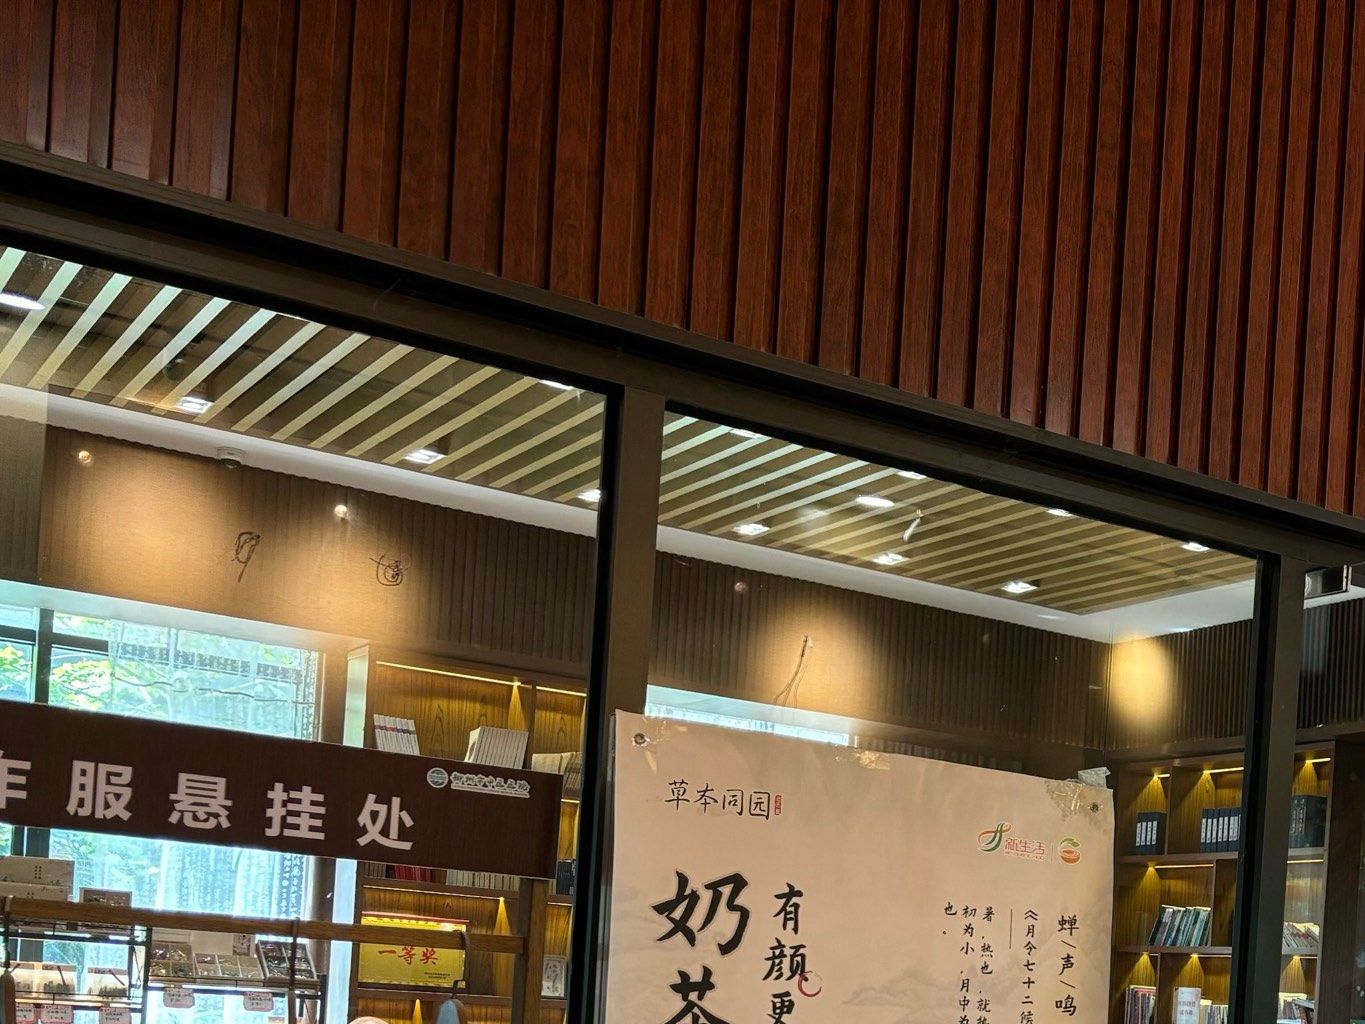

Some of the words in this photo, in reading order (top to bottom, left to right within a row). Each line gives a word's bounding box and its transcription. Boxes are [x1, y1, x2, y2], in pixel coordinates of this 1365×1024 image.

[664, 778, 771, 820] 草本同园
[378, 944, 439, 965] 一等奖
